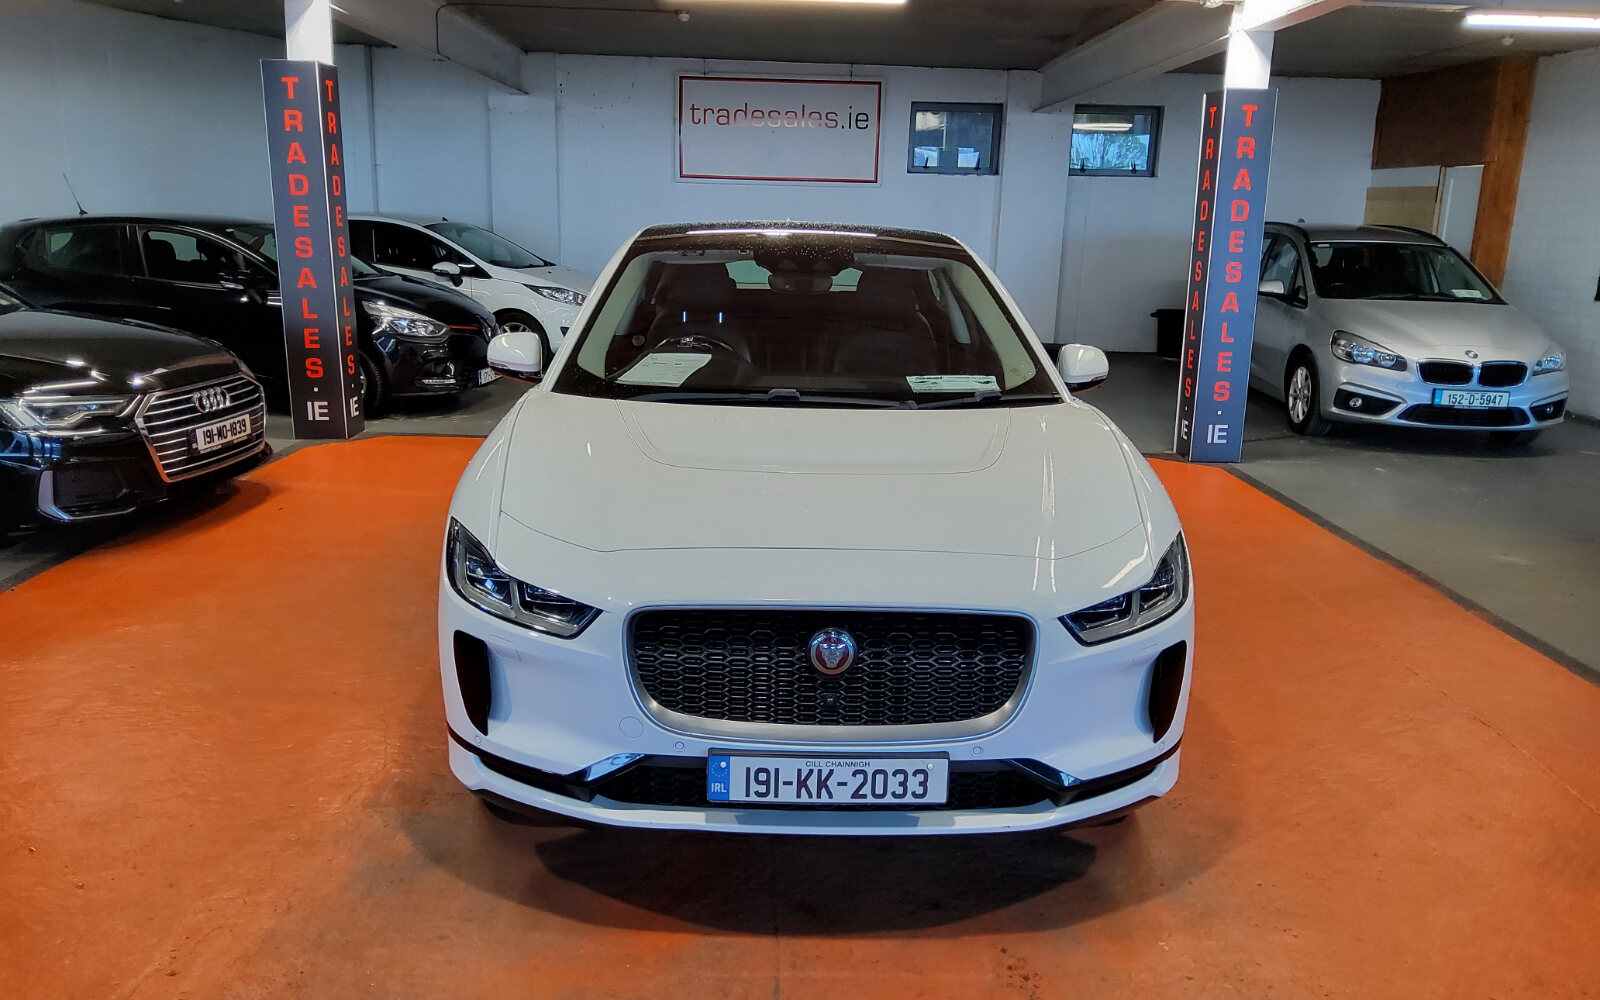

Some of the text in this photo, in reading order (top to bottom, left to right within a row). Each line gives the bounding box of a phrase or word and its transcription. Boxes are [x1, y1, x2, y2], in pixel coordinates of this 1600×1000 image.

[689, 102, 870, 130] tradesales.ie
[1447, 393, 1504, 406] 152-D-5947
[202, 418, 247, 446] 191-MO-1839
[805, 760, 871, 768] CILL CHAINNIGH
[711, 783, 728, 793] IRL
[744, 766, 930, 800] 191-KK-2033
